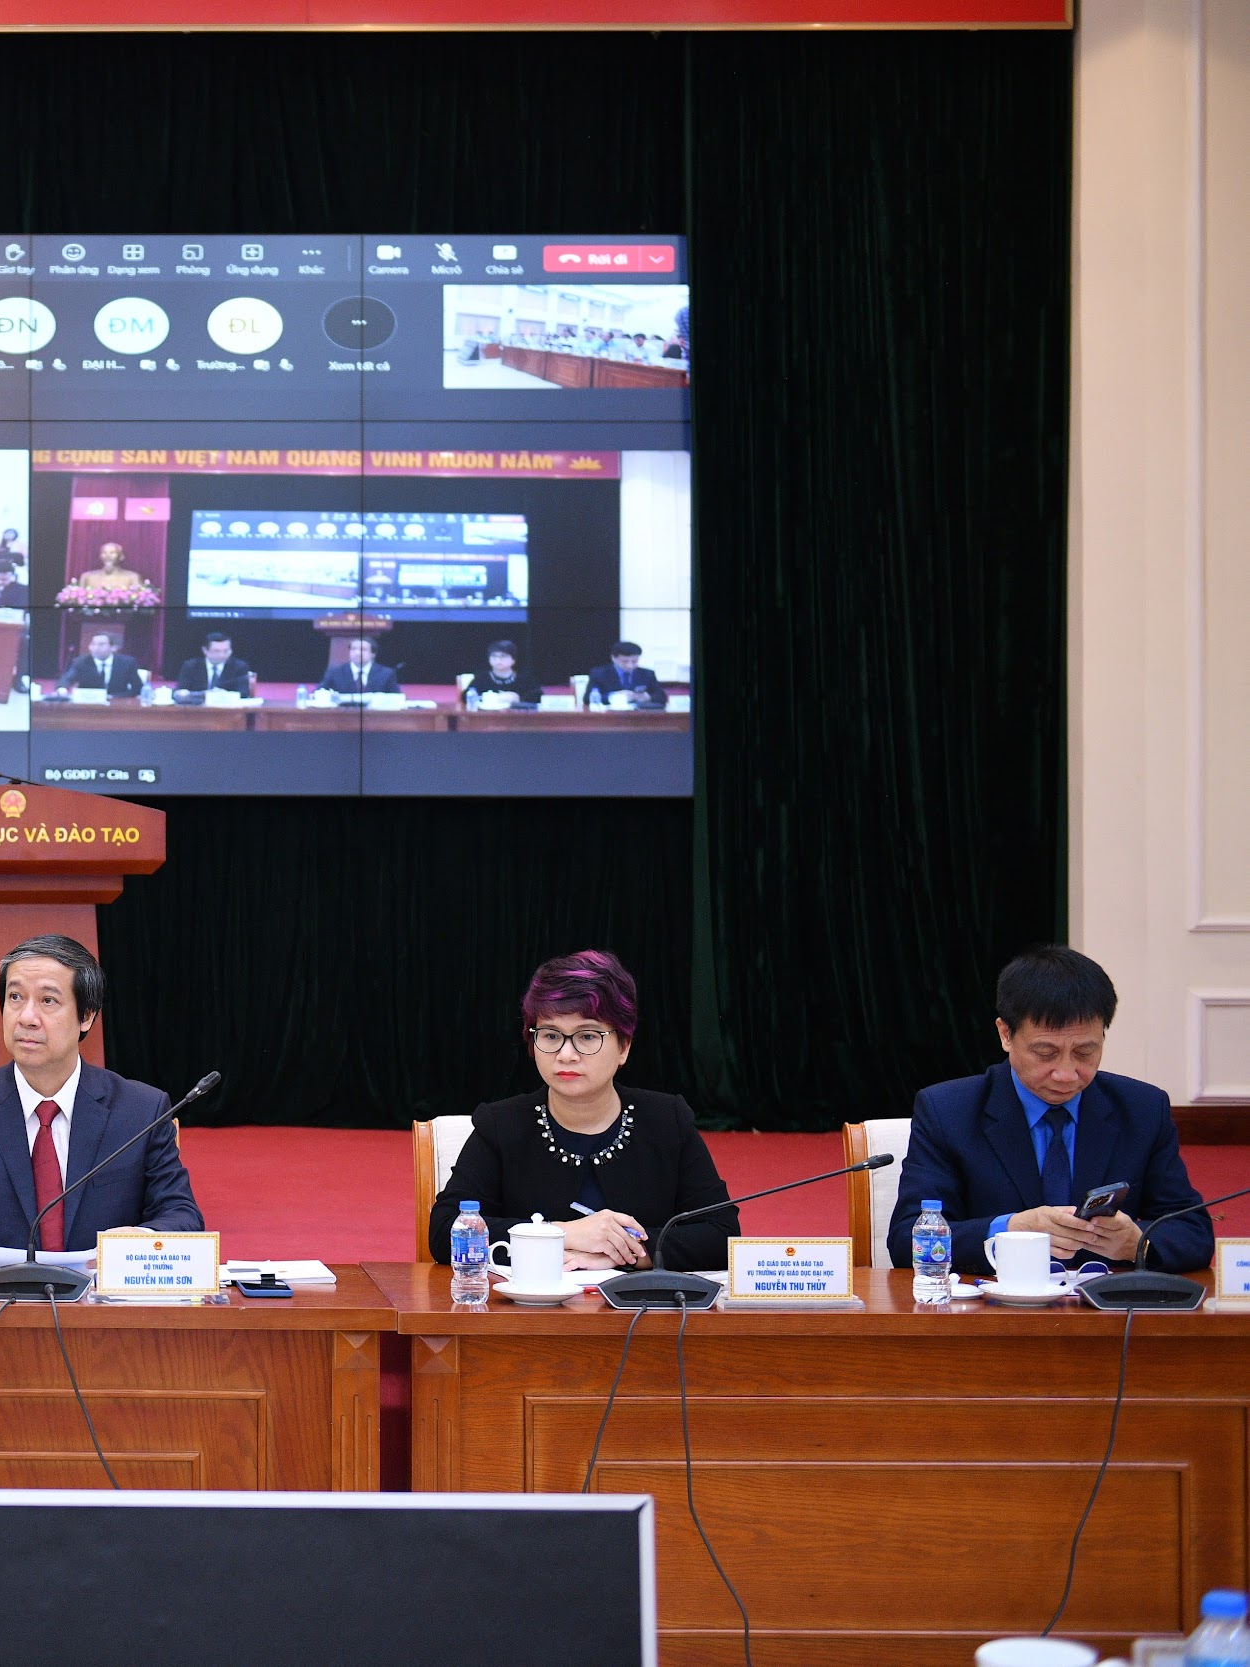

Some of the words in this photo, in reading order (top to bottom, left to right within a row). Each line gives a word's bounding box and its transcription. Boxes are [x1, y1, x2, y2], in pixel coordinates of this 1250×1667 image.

[176, 265, 210, 276] Phòng
[298, 265, 325, 275] Khác
[368, 265, 409, 275] Camera
[485, 265, 510, 275] Chia
[108, 317, 154, 333] ĐM
[228, 317, 262, 333] ĐL
[328, 361, 355, 371] Xem
[227, 450, 279, 466] NAM
[286, 450, 361, 467] QUANG
[369, 451, 423, 468] VINH
[24, 823, 50, 843] VÀ
[54, 823, 96, 844] ĐÀO
[100, 827, 140, 846] TẠO
[126, 1254, 134, 1262] BỘ
[148, 1254, 159, 1262] DỤC
[161, 1254, 168, 1262] VÀ
[181, 1254, 191, 1262] TẠO
[144, 1263, 151, 1271] BỘ
[125, 1273, 156, 1284] NGUYỄN
[158, 1276, 174, 1284] KIM
[176, 1275, 192, 1284] SƠN
[755, 1279, 787, 1290] NGUYỄN
[789, 1282, 804, 1290] THU
[807, 1279, 826, 1290] THỦY
